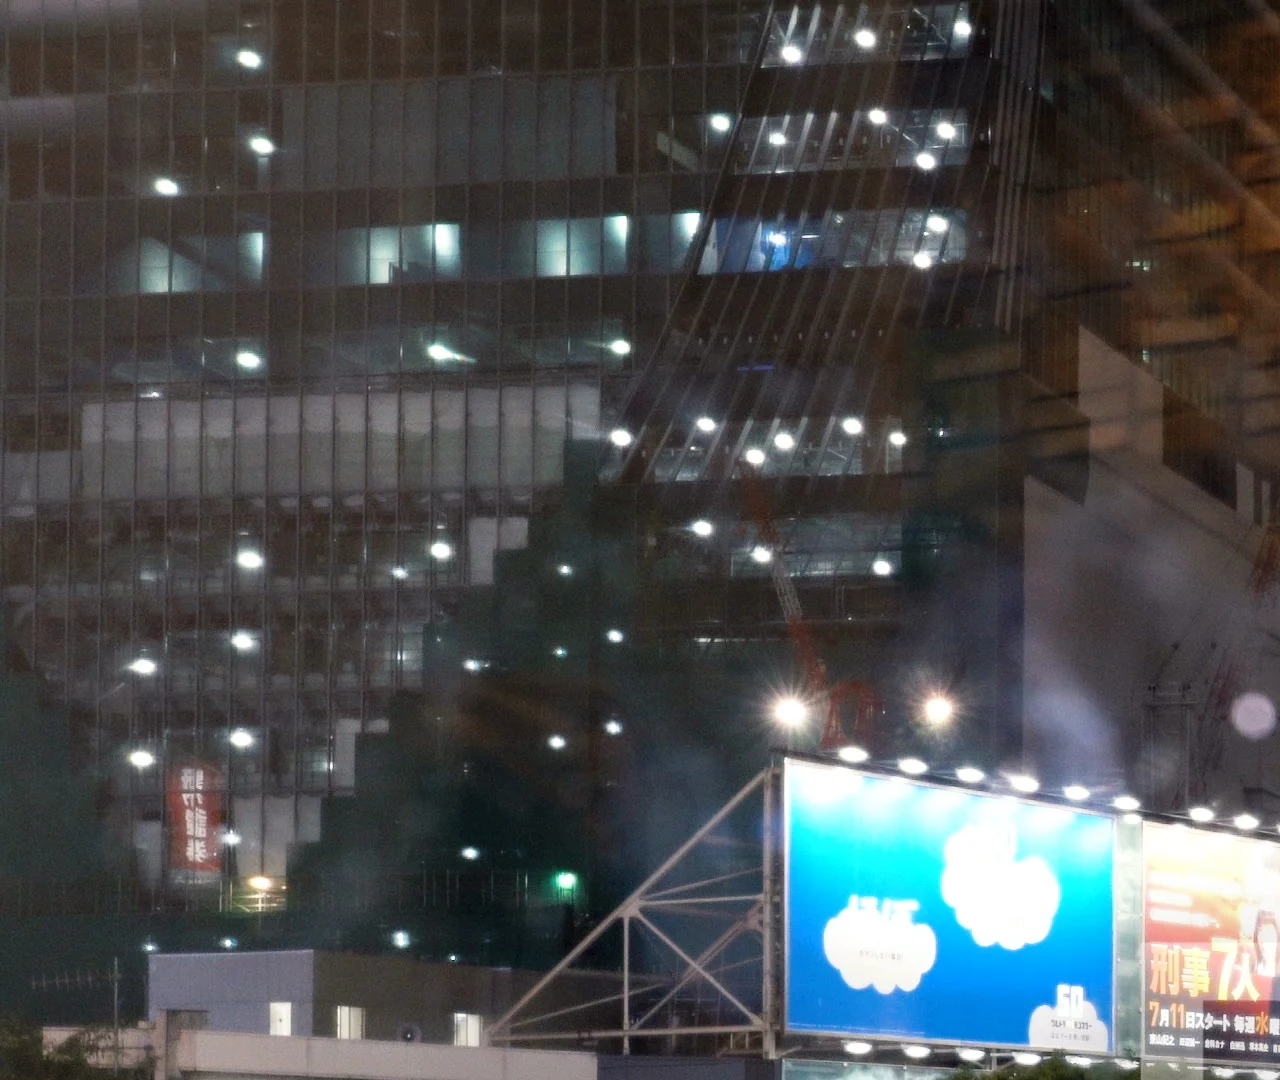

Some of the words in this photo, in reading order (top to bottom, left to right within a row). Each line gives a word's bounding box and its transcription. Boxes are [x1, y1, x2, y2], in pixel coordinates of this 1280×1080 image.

[1149, 936, 1261, 1003] 刑事7人
[1149, 1001, 1231, 1032] 7月11日スタート
